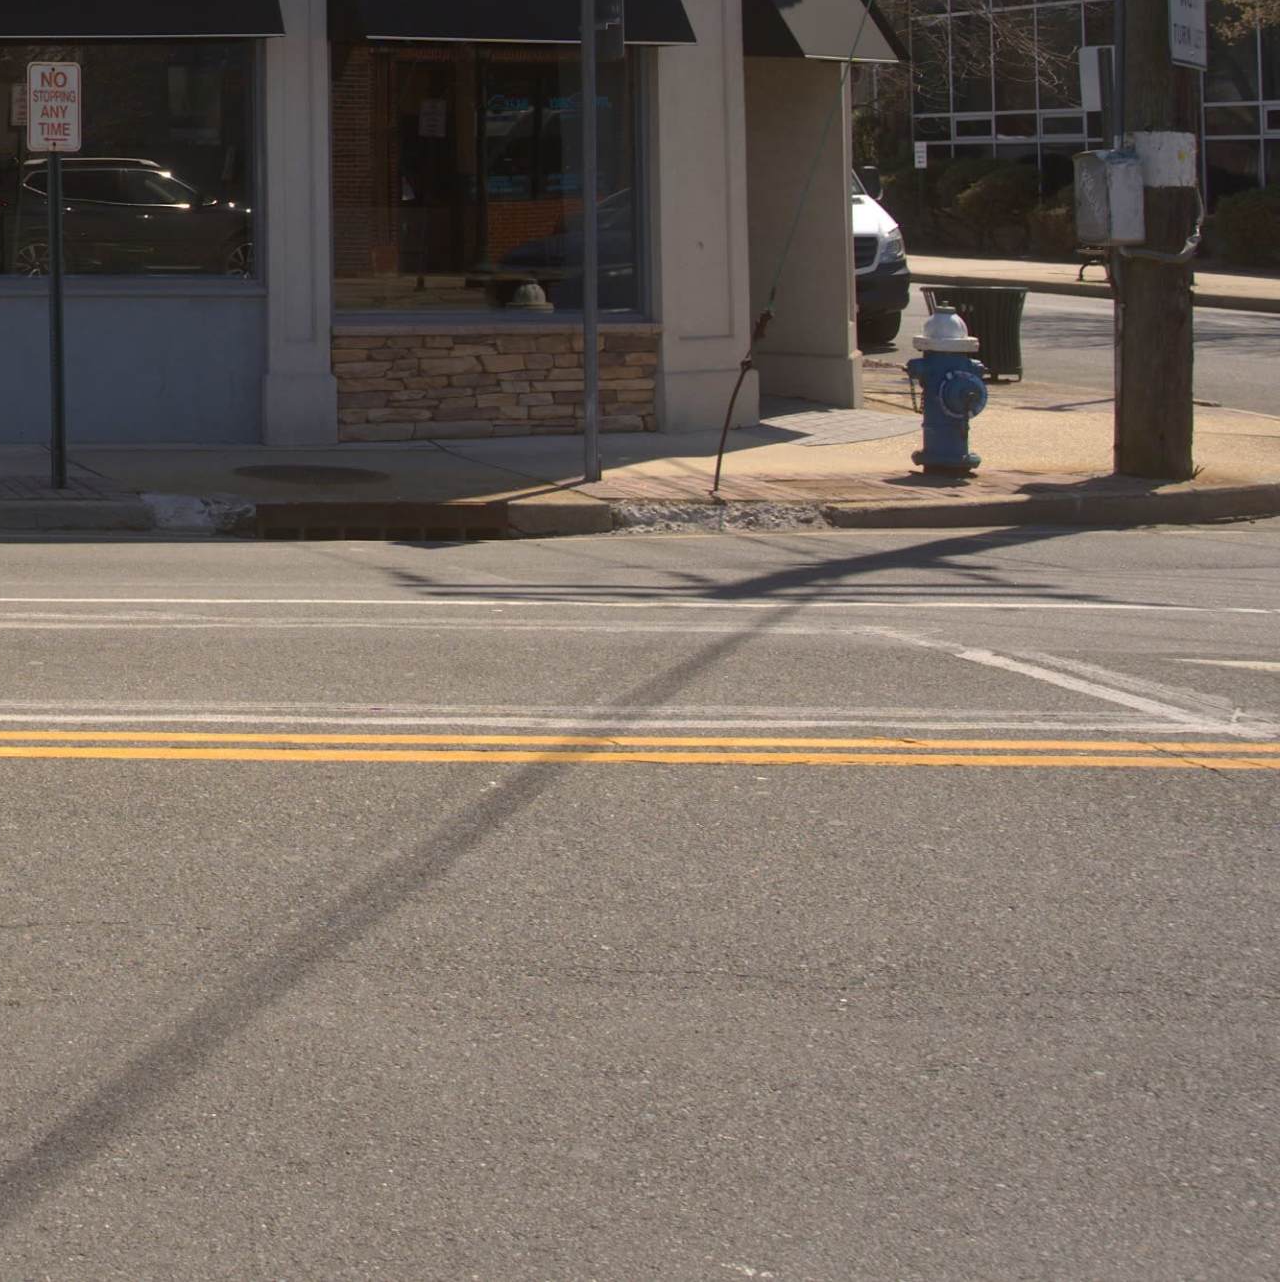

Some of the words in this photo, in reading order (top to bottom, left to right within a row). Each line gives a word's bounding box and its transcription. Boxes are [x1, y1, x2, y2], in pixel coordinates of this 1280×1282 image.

[40, 72, 67, 88] NO
[32, 90, 76, 103] STOPPING
[40, 106, 68, 119] ANY
[37, 122, 71, 137] TIME
